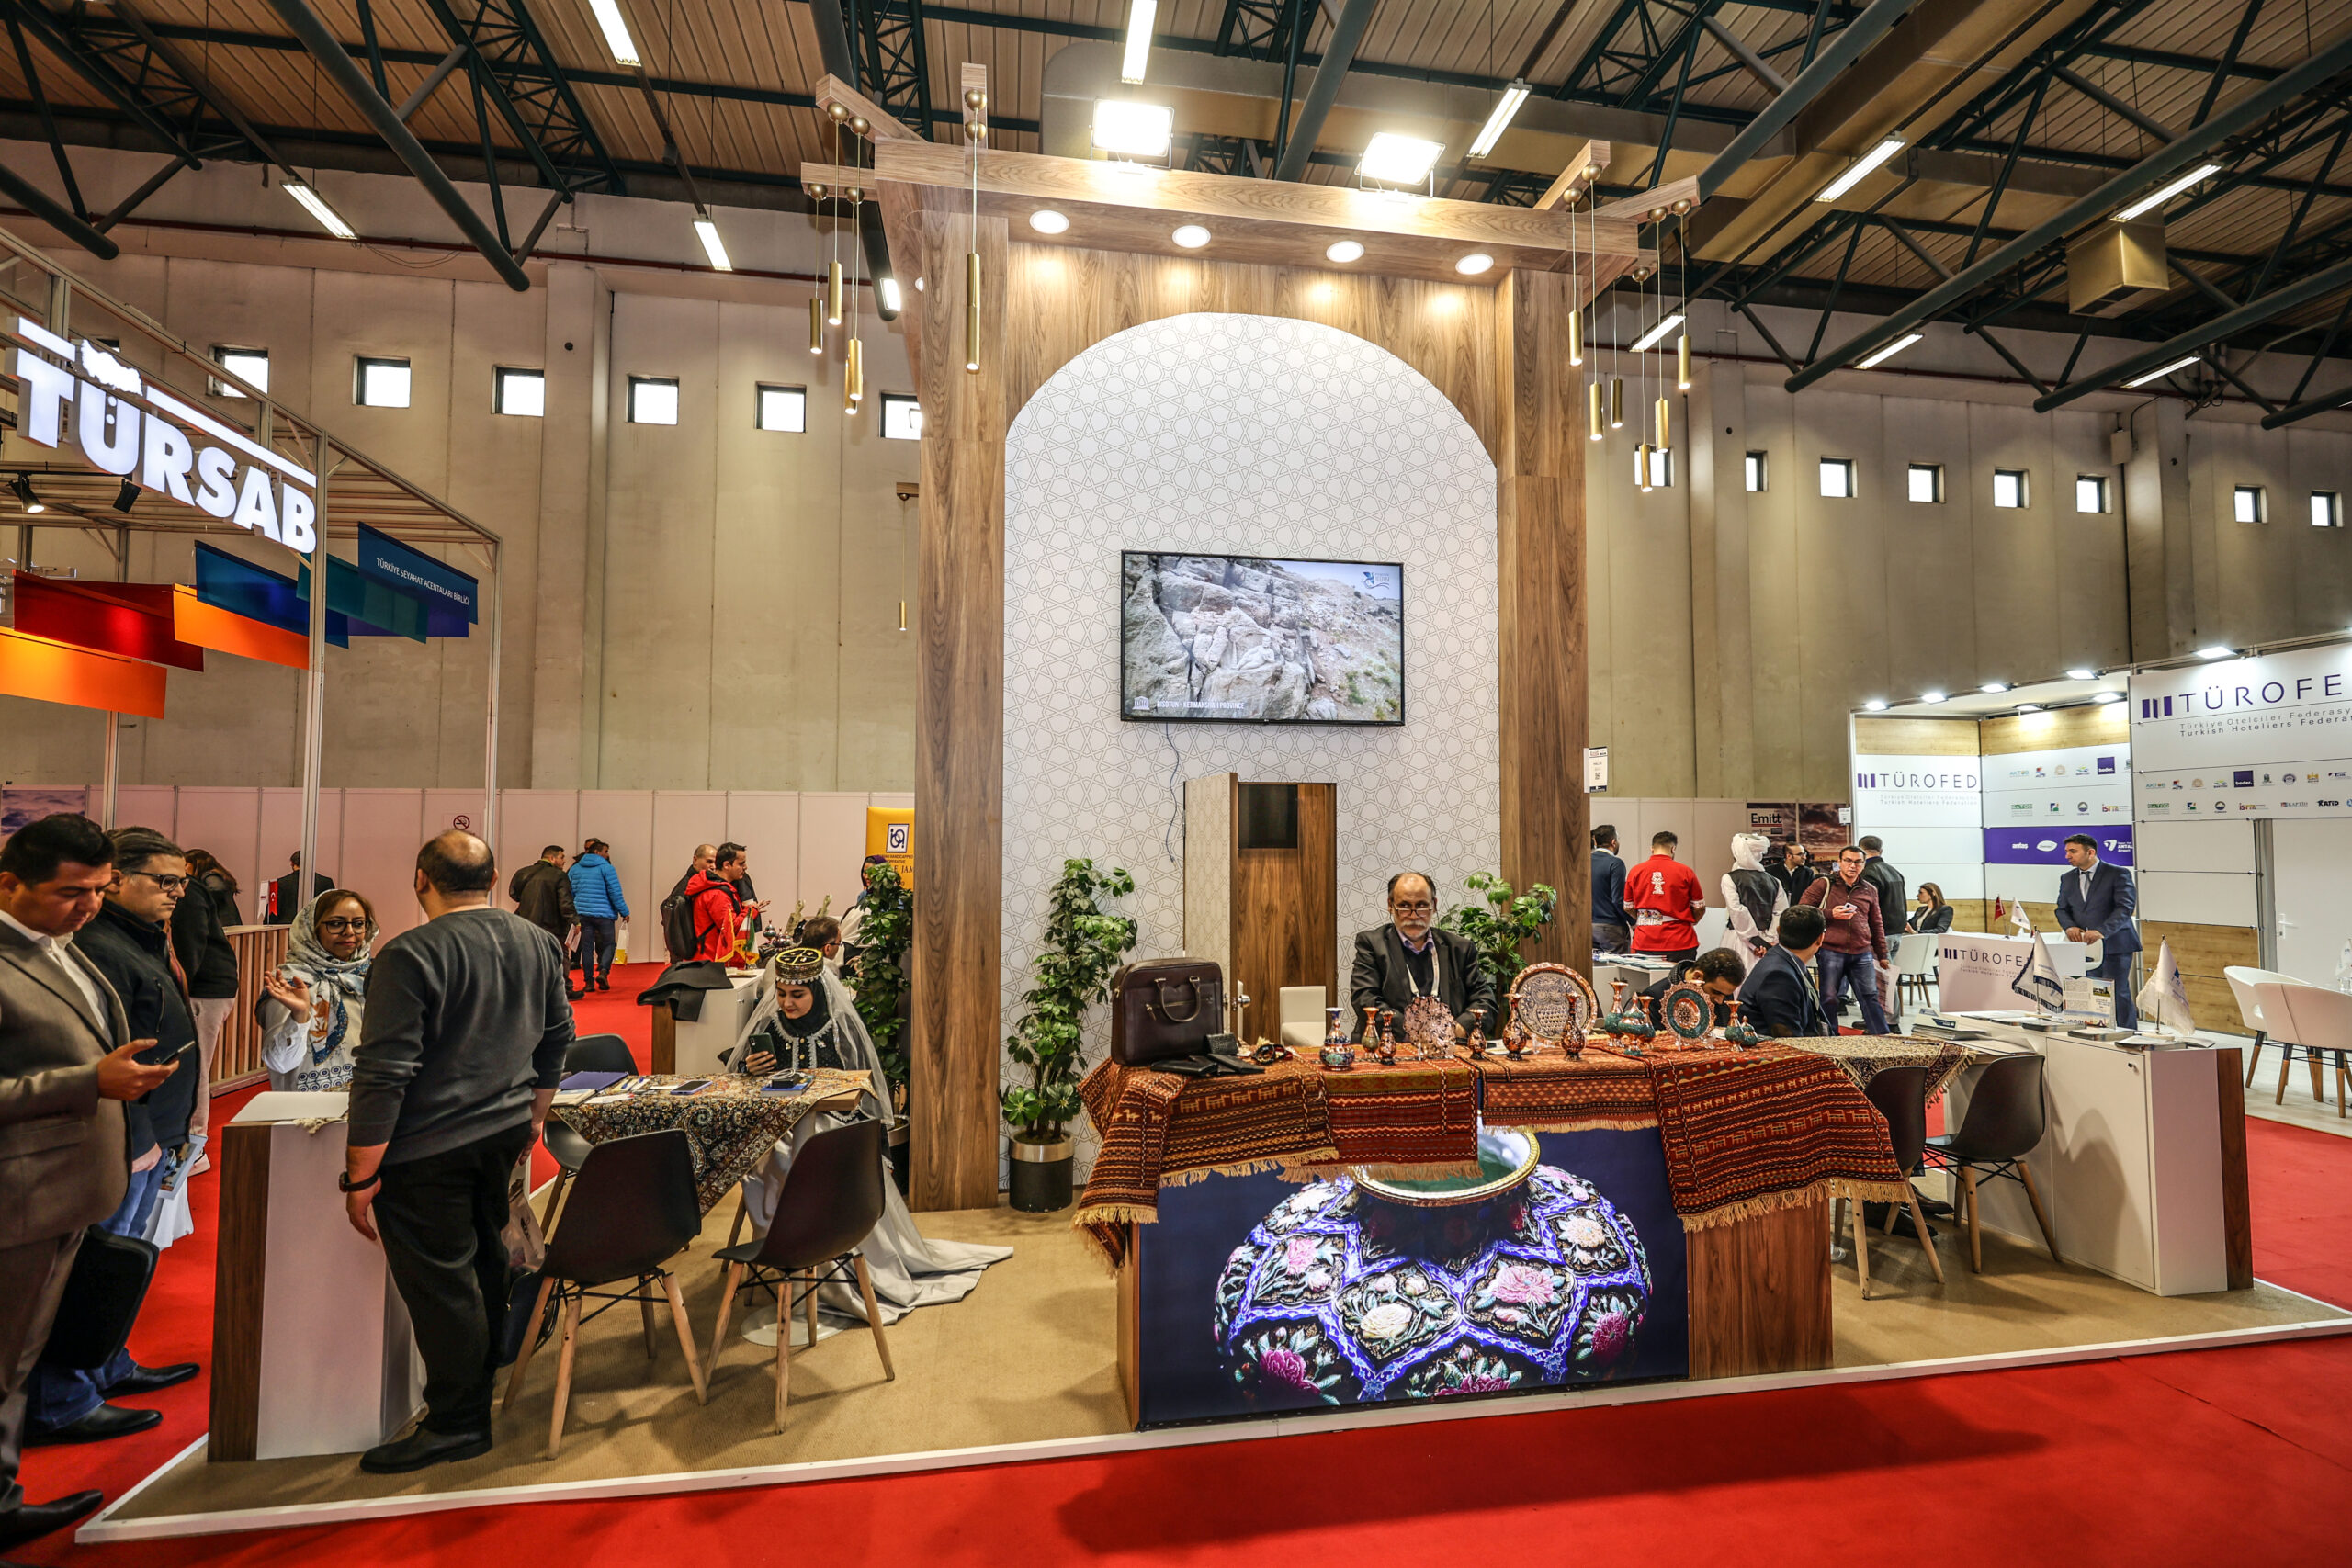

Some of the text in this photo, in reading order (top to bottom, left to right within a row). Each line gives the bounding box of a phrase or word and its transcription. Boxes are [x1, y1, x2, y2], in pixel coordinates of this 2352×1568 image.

[17, 347, 317, 554] TÜRSAB
[376, 558, 400, 576] TÜRKİYE
[400, 569, 424, 585] SEYAHAT
[424, 580, 454, 600] ACENTALARI
[1183, 701, 1219, 709] KERMANSHAH
[2180, 720, 2222, 730] Türkiye
[2226, 715, 2282, 726] Otelciler
[2180, 727, 2224, 738] Turkish
[2232, 721, 2292, 733] Hoteliers
[1879, 771, 1978, 789] TÜROFED
[1751, 813, 1782, 824] Emitt
[1959, 949, 2030, 967] TÜROFE
